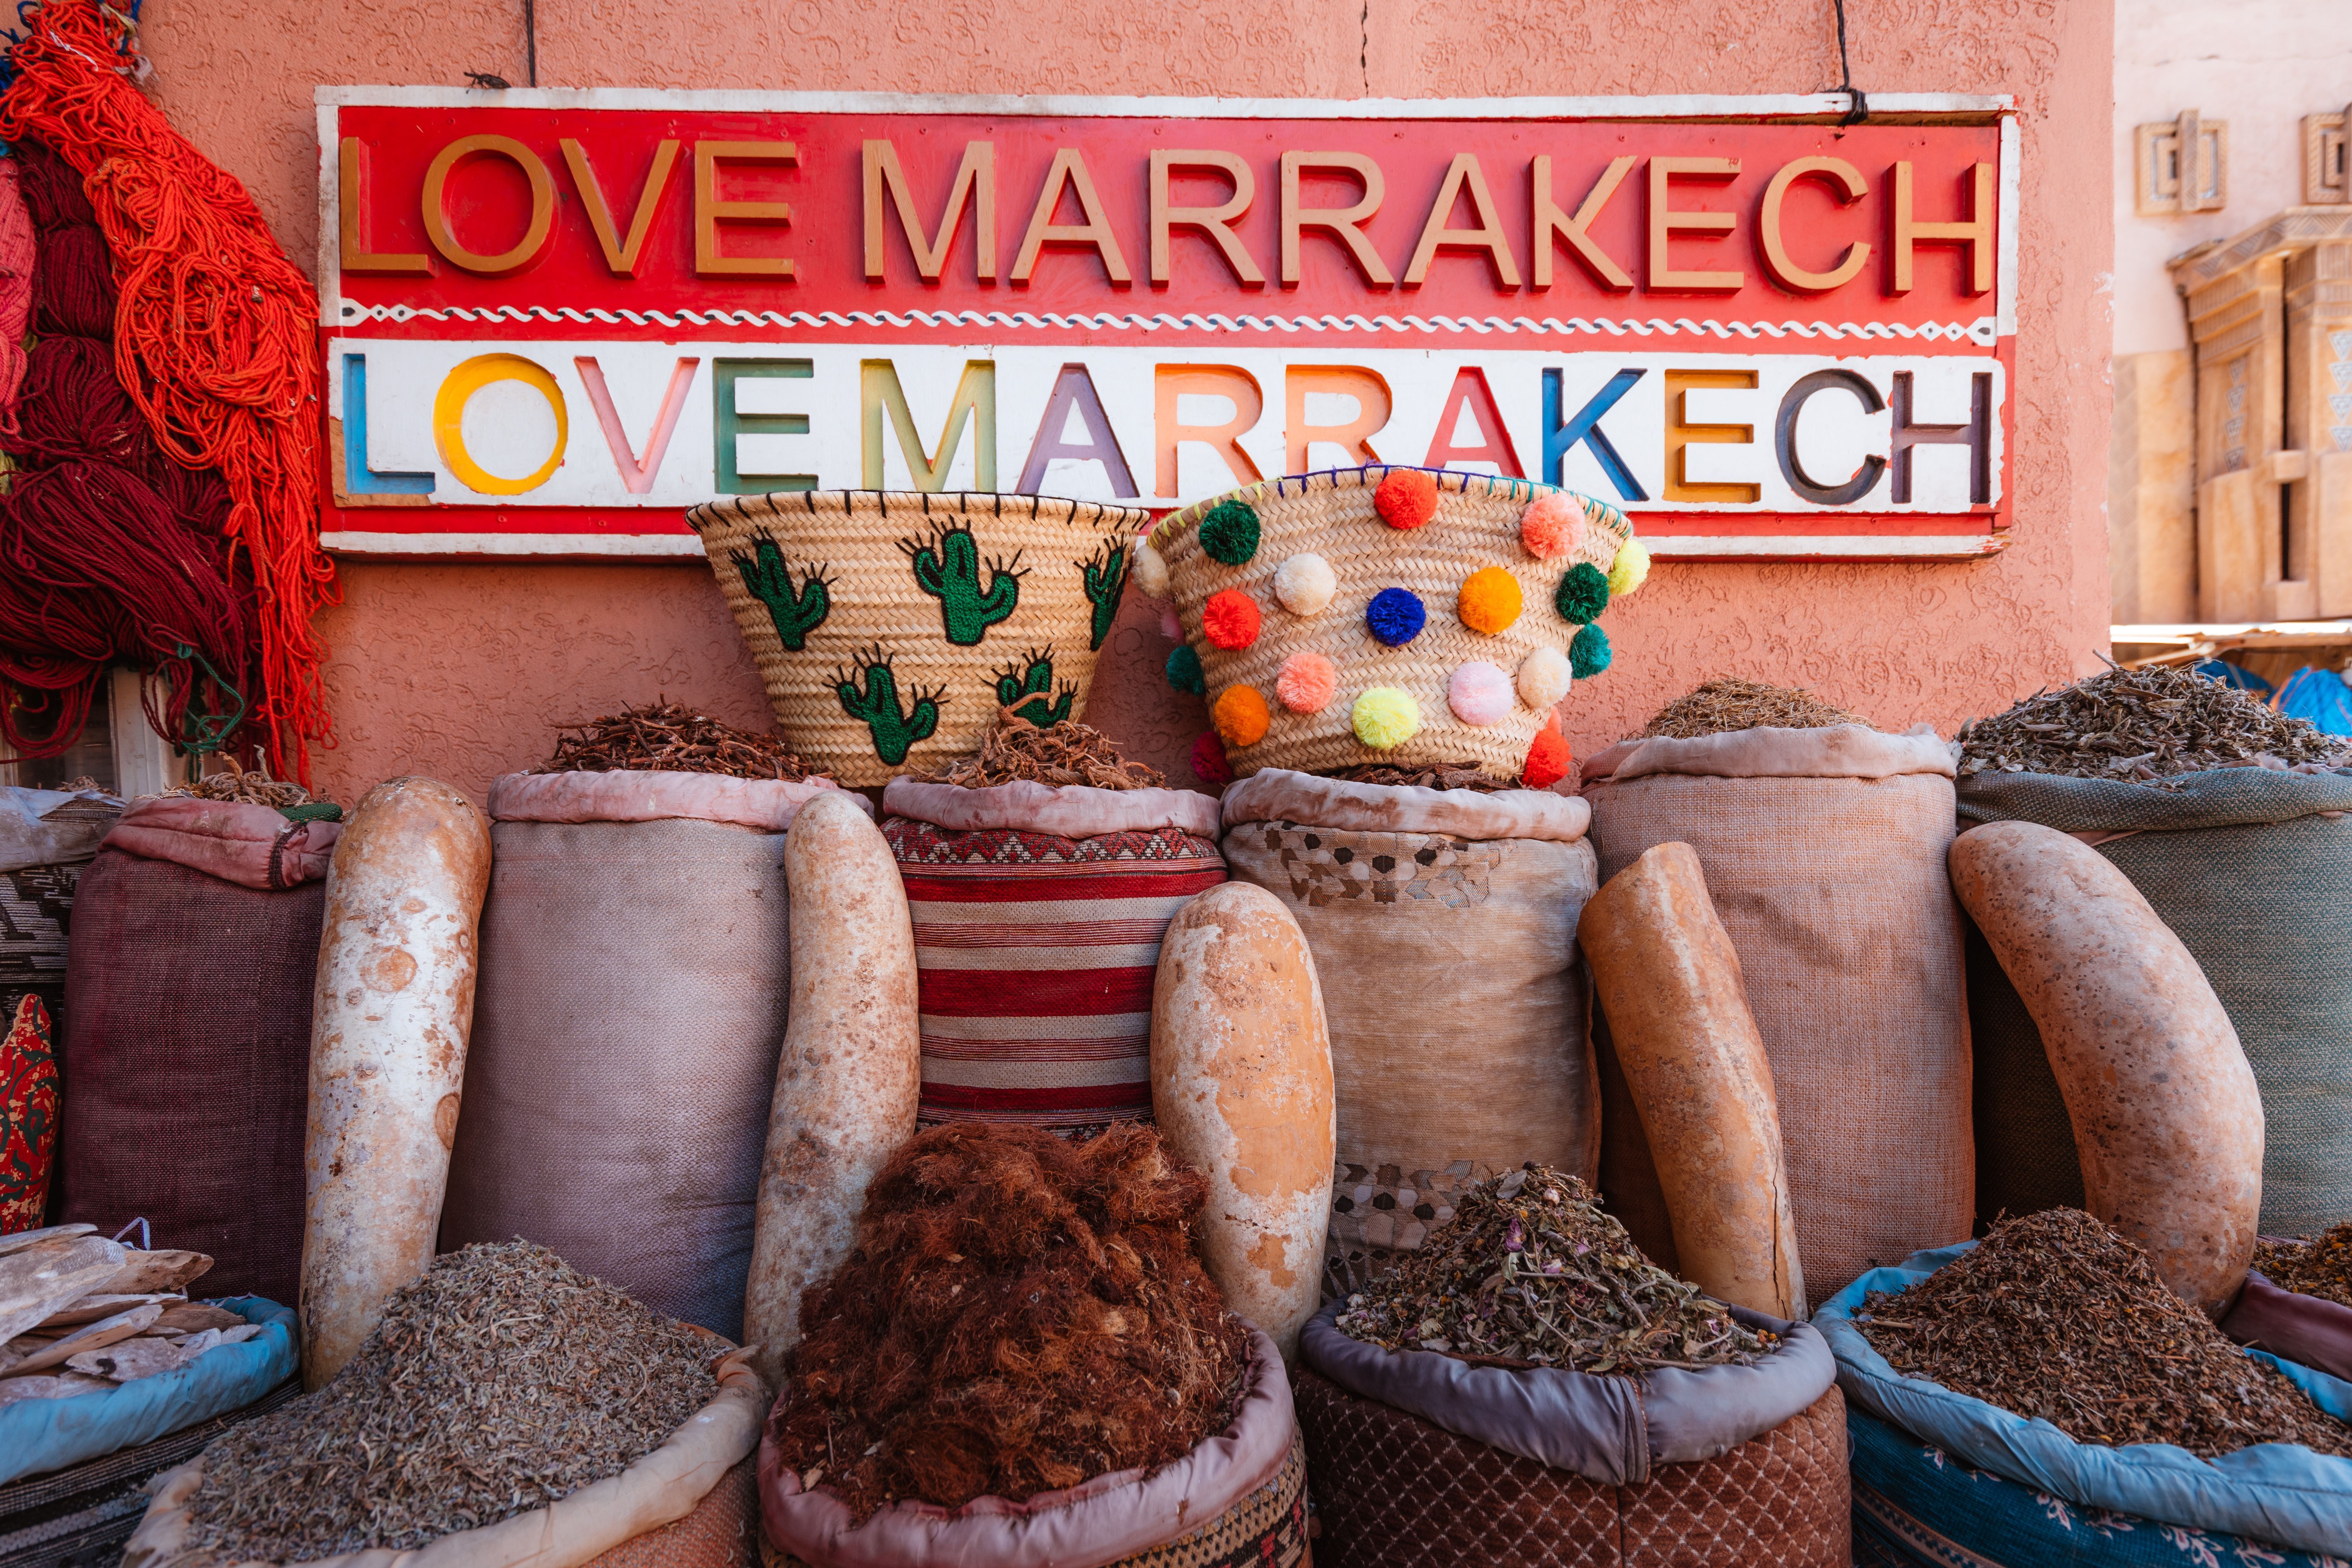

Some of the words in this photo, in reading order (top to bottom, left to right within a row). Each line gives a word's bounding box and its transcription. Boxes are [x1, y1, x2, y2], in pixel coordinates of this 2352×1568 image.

[340, 134, 798, 280] LOVE
[861, 139, 1993, 298] MARRAKECH
[342, 352, 819, 495] LOVE
[859, 358, 1992, 505] MARRAKECH
